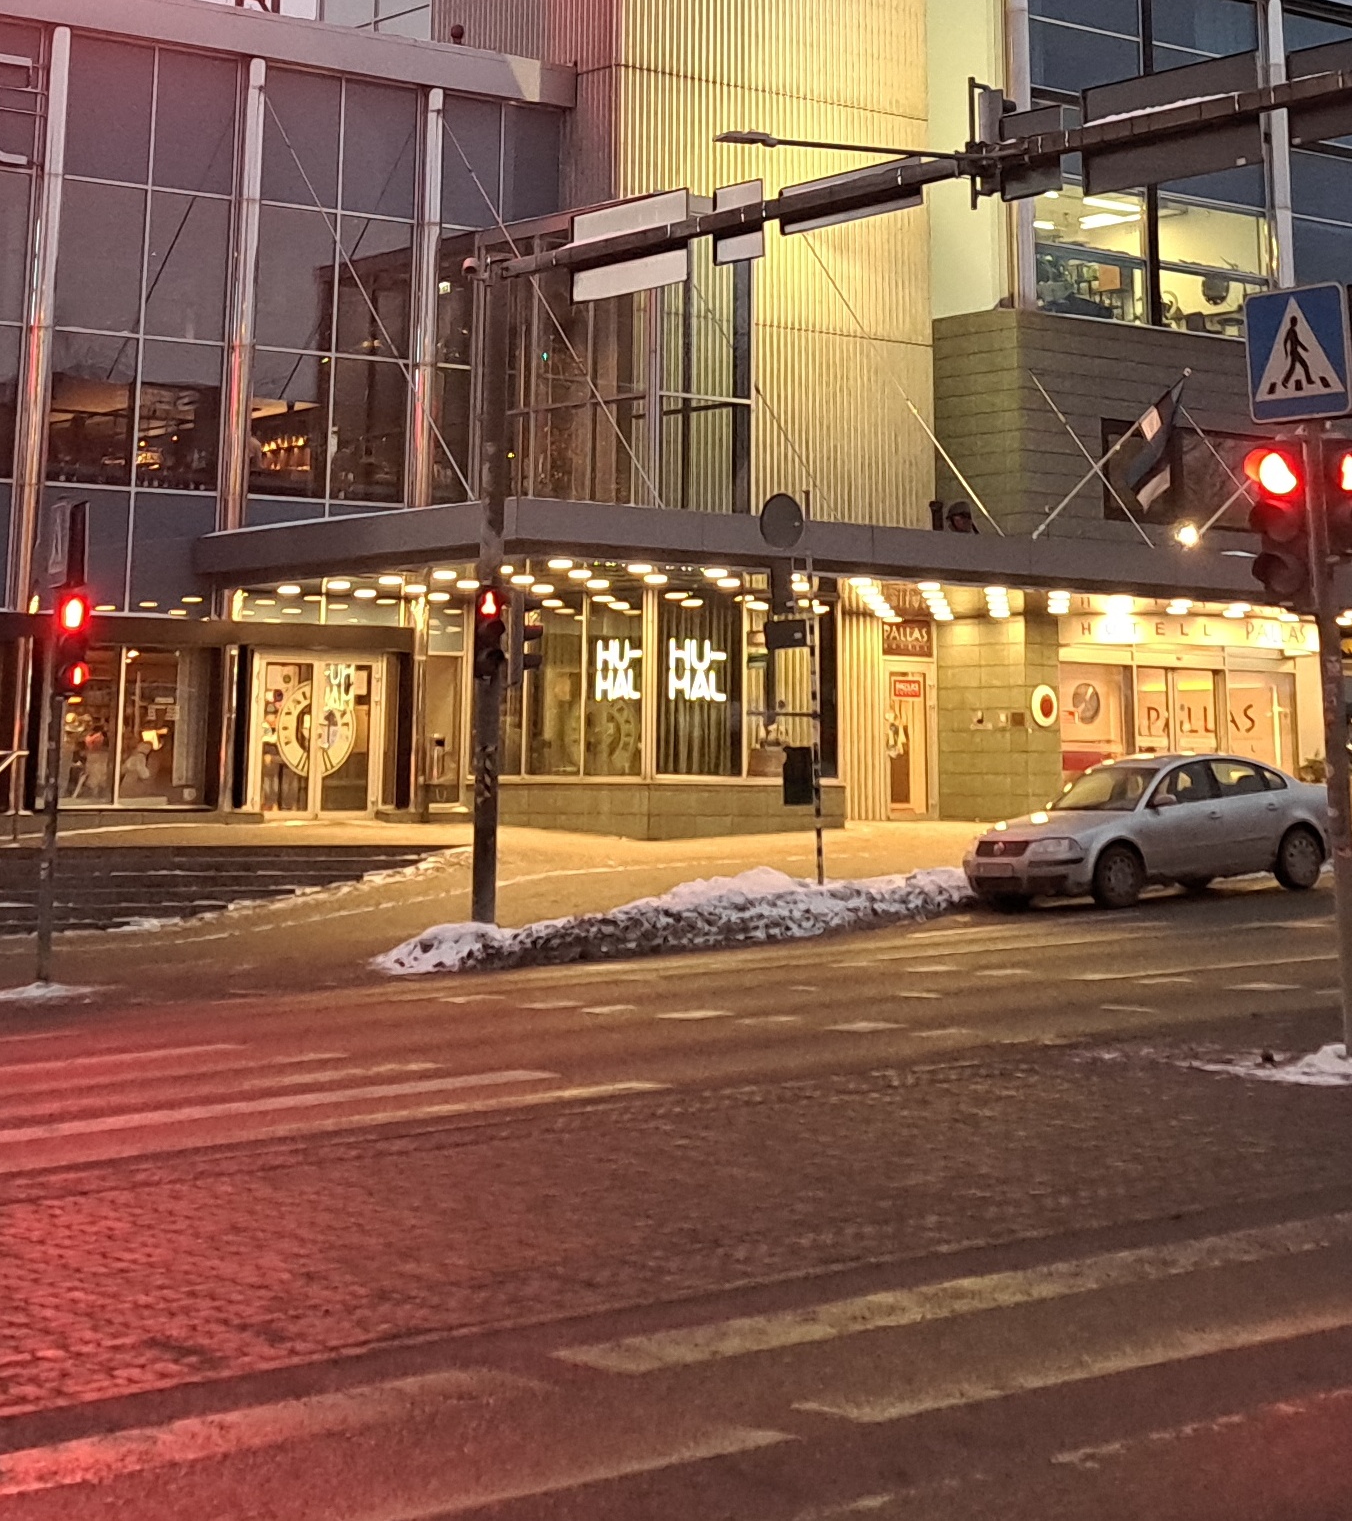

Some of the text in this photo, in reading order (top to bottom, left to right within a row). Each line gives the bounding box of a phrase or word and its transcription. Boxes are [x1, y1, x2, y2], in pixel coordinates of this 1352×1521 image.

[883, 624, 928, 642] PALLAS
[1246, 621, 1306, 644] PALLAS
[1147, 704, 1255, 735] PLLAS
